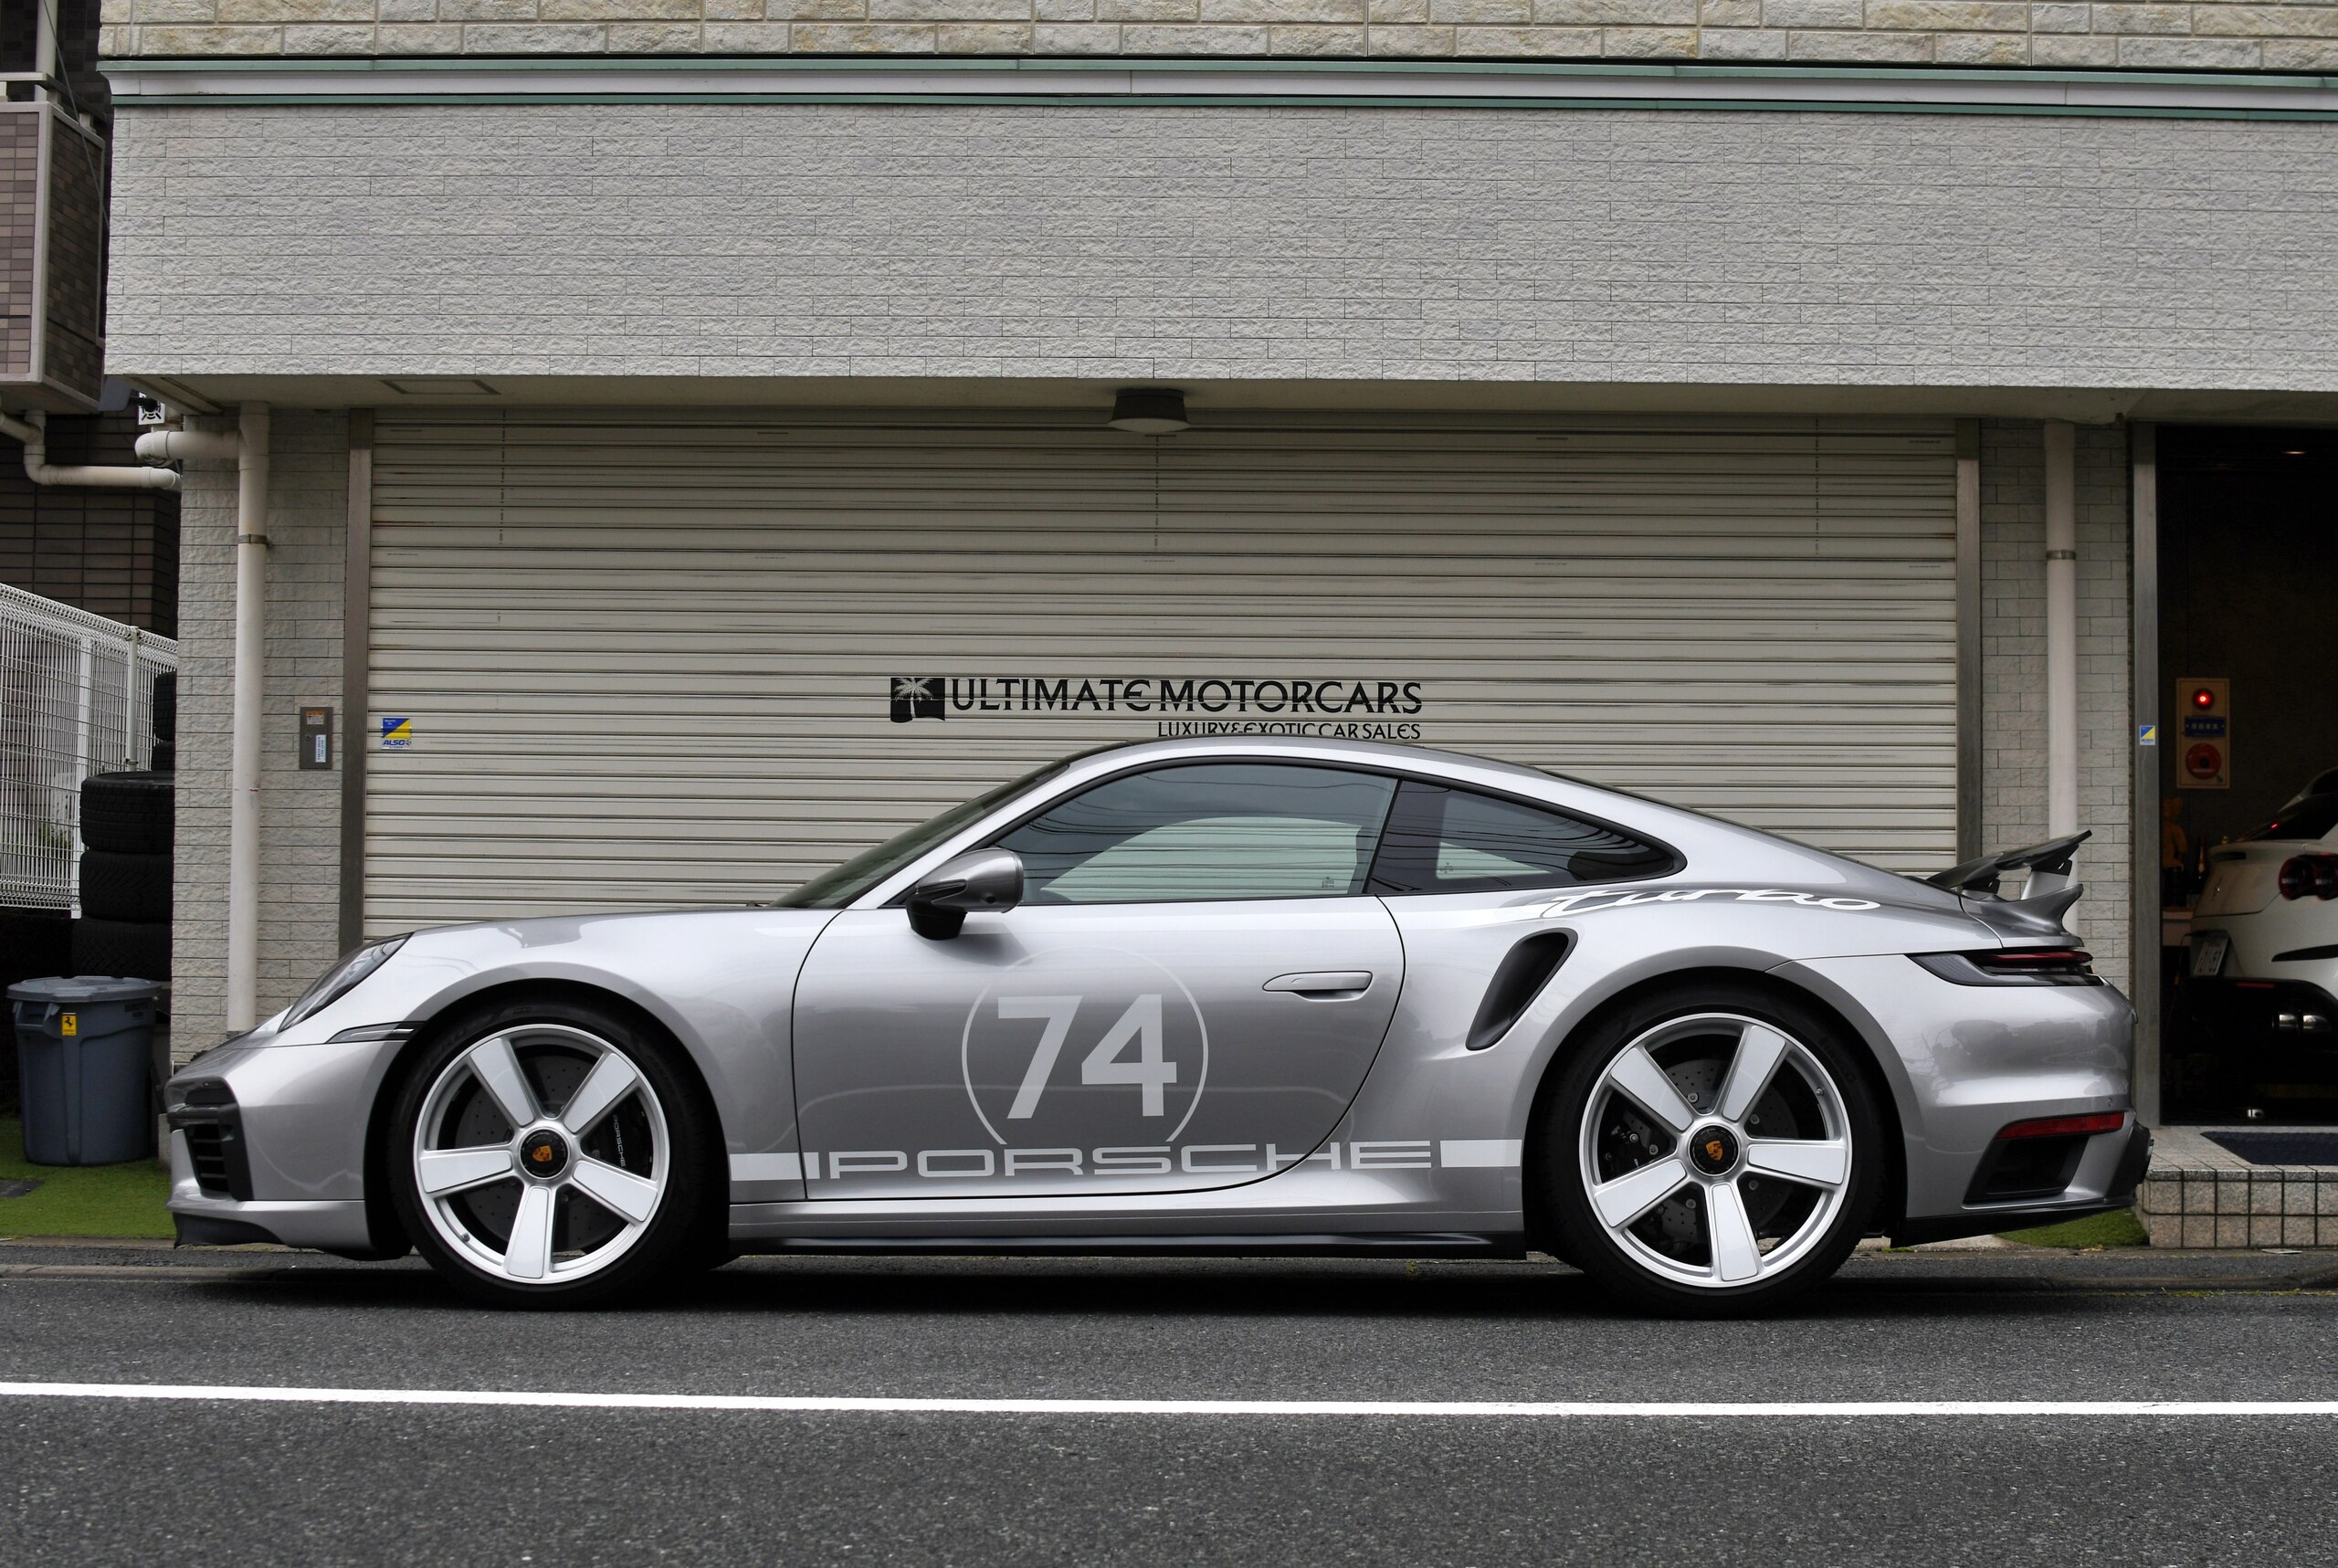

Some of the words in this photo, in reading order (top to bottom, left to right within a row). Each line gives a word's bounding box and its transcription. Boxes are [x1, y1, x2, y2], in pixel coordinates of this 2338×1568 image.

[951, 679, 1152, 711] ULTIMATE
[1159, 679, 1423, 715] MOTORCARS
[1540, 889, 1881, 919] turbo
[996, 993, 1177, 1120] 74
[828, 1139, 1433, 1180] PORSCHE
